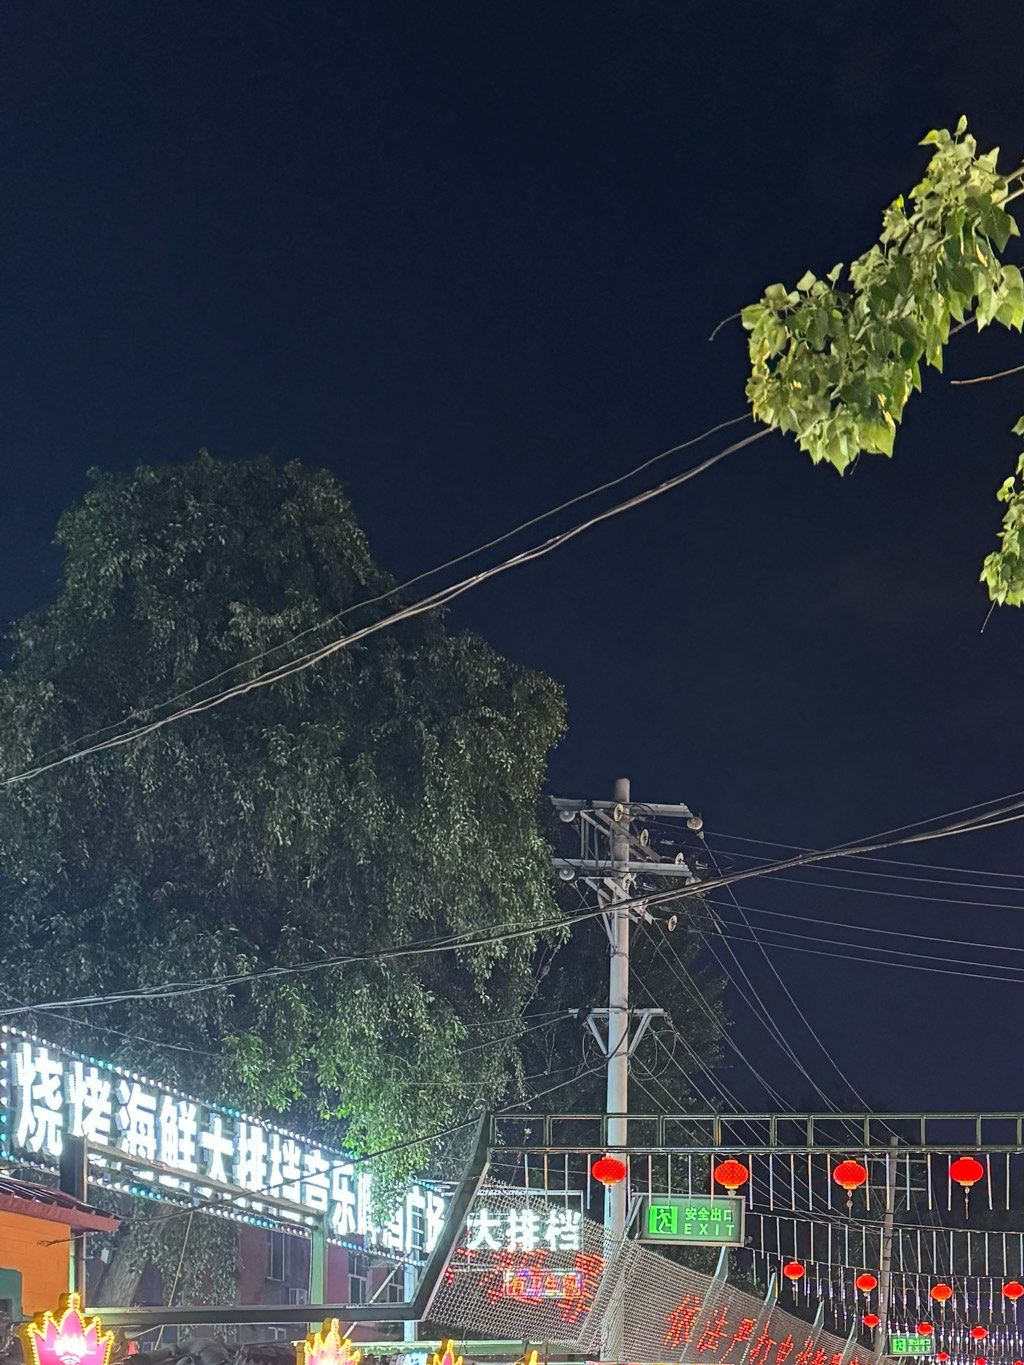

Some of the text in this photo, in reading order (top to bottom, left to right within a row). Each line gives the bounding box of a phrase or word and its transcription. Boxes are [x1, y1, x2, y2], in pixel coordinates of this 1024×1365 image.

[685, 1207, 733, 1221] 安全出口
[467, 1208, 582, 1250] 大排档
[684, 1222, 735, 1236] EXIT
